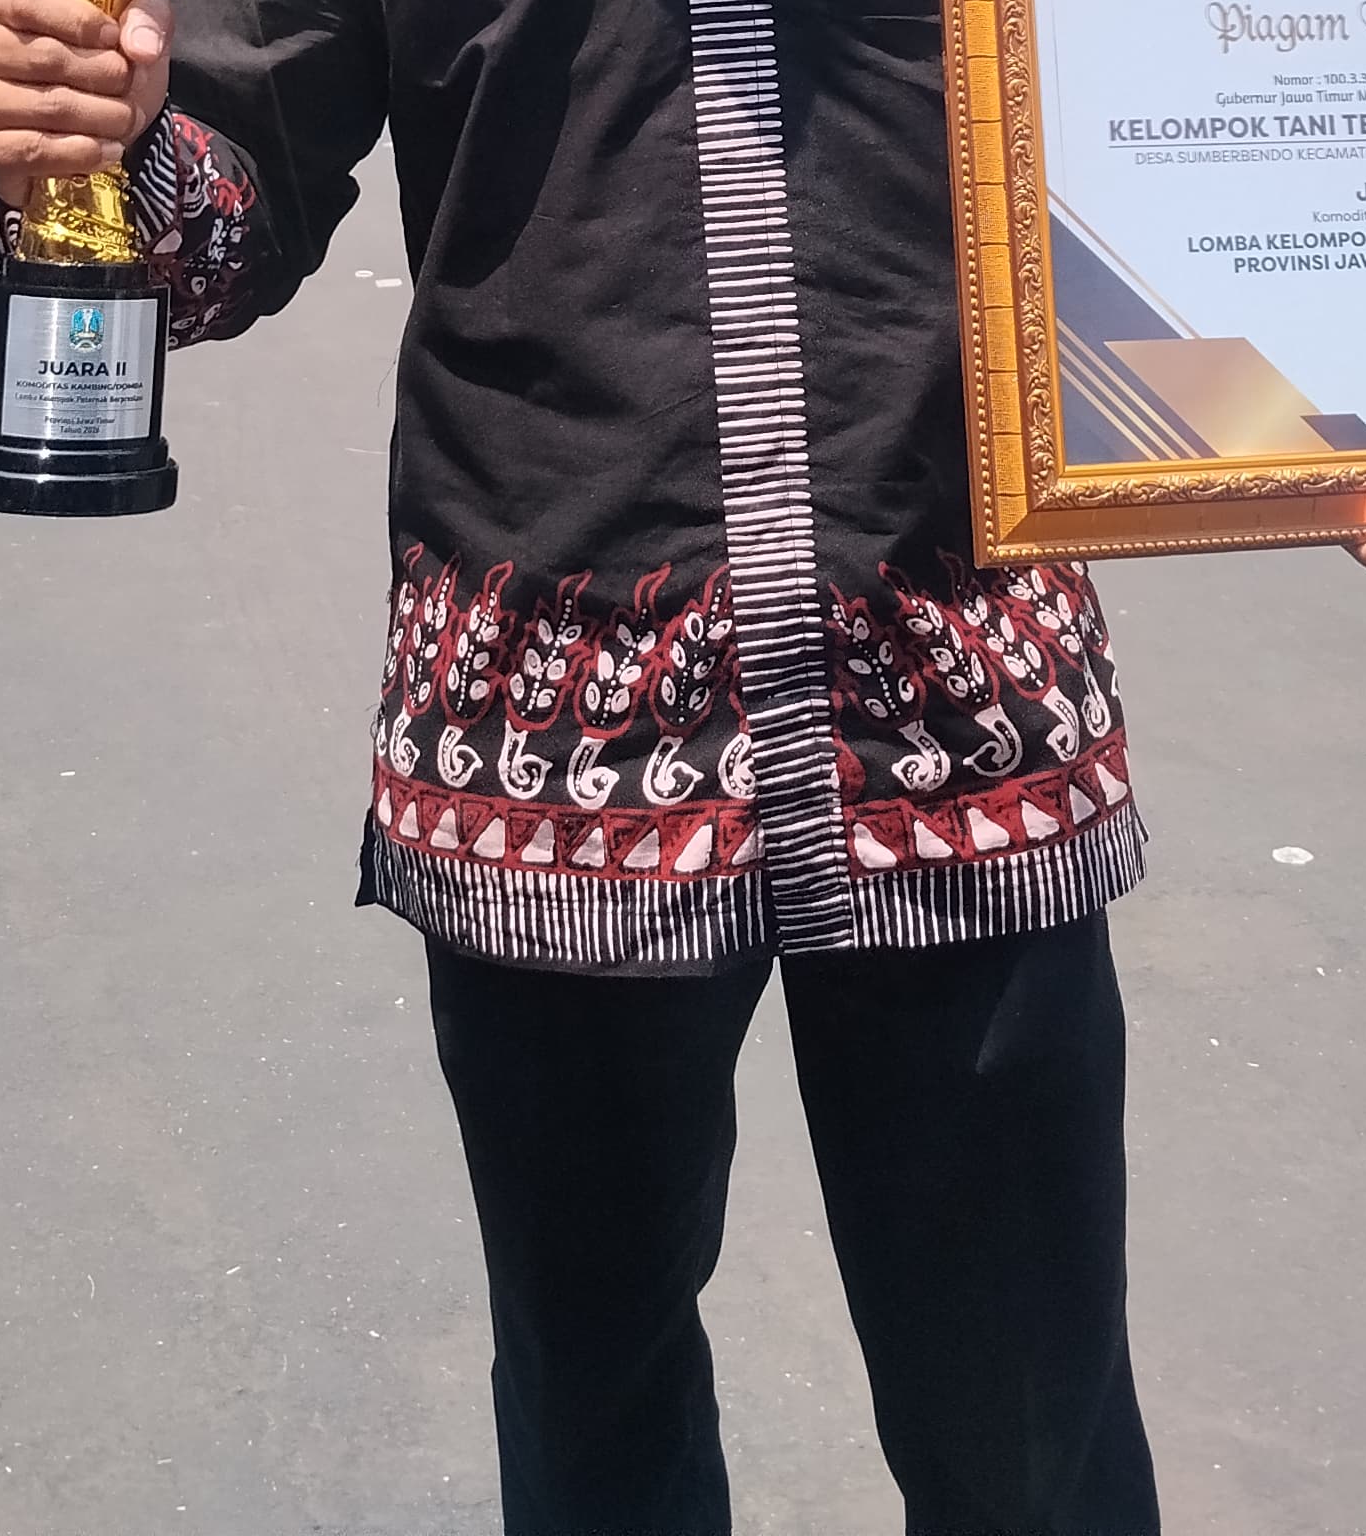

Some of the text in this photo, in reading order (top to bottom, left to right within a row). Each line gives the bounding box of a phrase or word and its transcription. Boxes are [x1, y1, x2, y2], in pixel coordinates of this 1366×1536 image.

[1205, 0, 1350, 54] Piagam
[1274, 74, 1314, 86] Nomor
[1216, 91, 1278, 107] Gubernur
[1281, 91, 1313, 106] Jawa
[1316, 90, 1355, 103] Timur
[1109, 116, 1270, 142] KELOMPOK
[1273, 114, 1337, 137] TANI
[1135, 151, 1175, 165] DESA
[1177, 148, 1294, 164] SUMBERBENDO
[1187, 235, 1263, 253] LOMBA
[1234, 254, 1330, 274] PROVINSI
[37, 360, 127, 378] JUARA II
